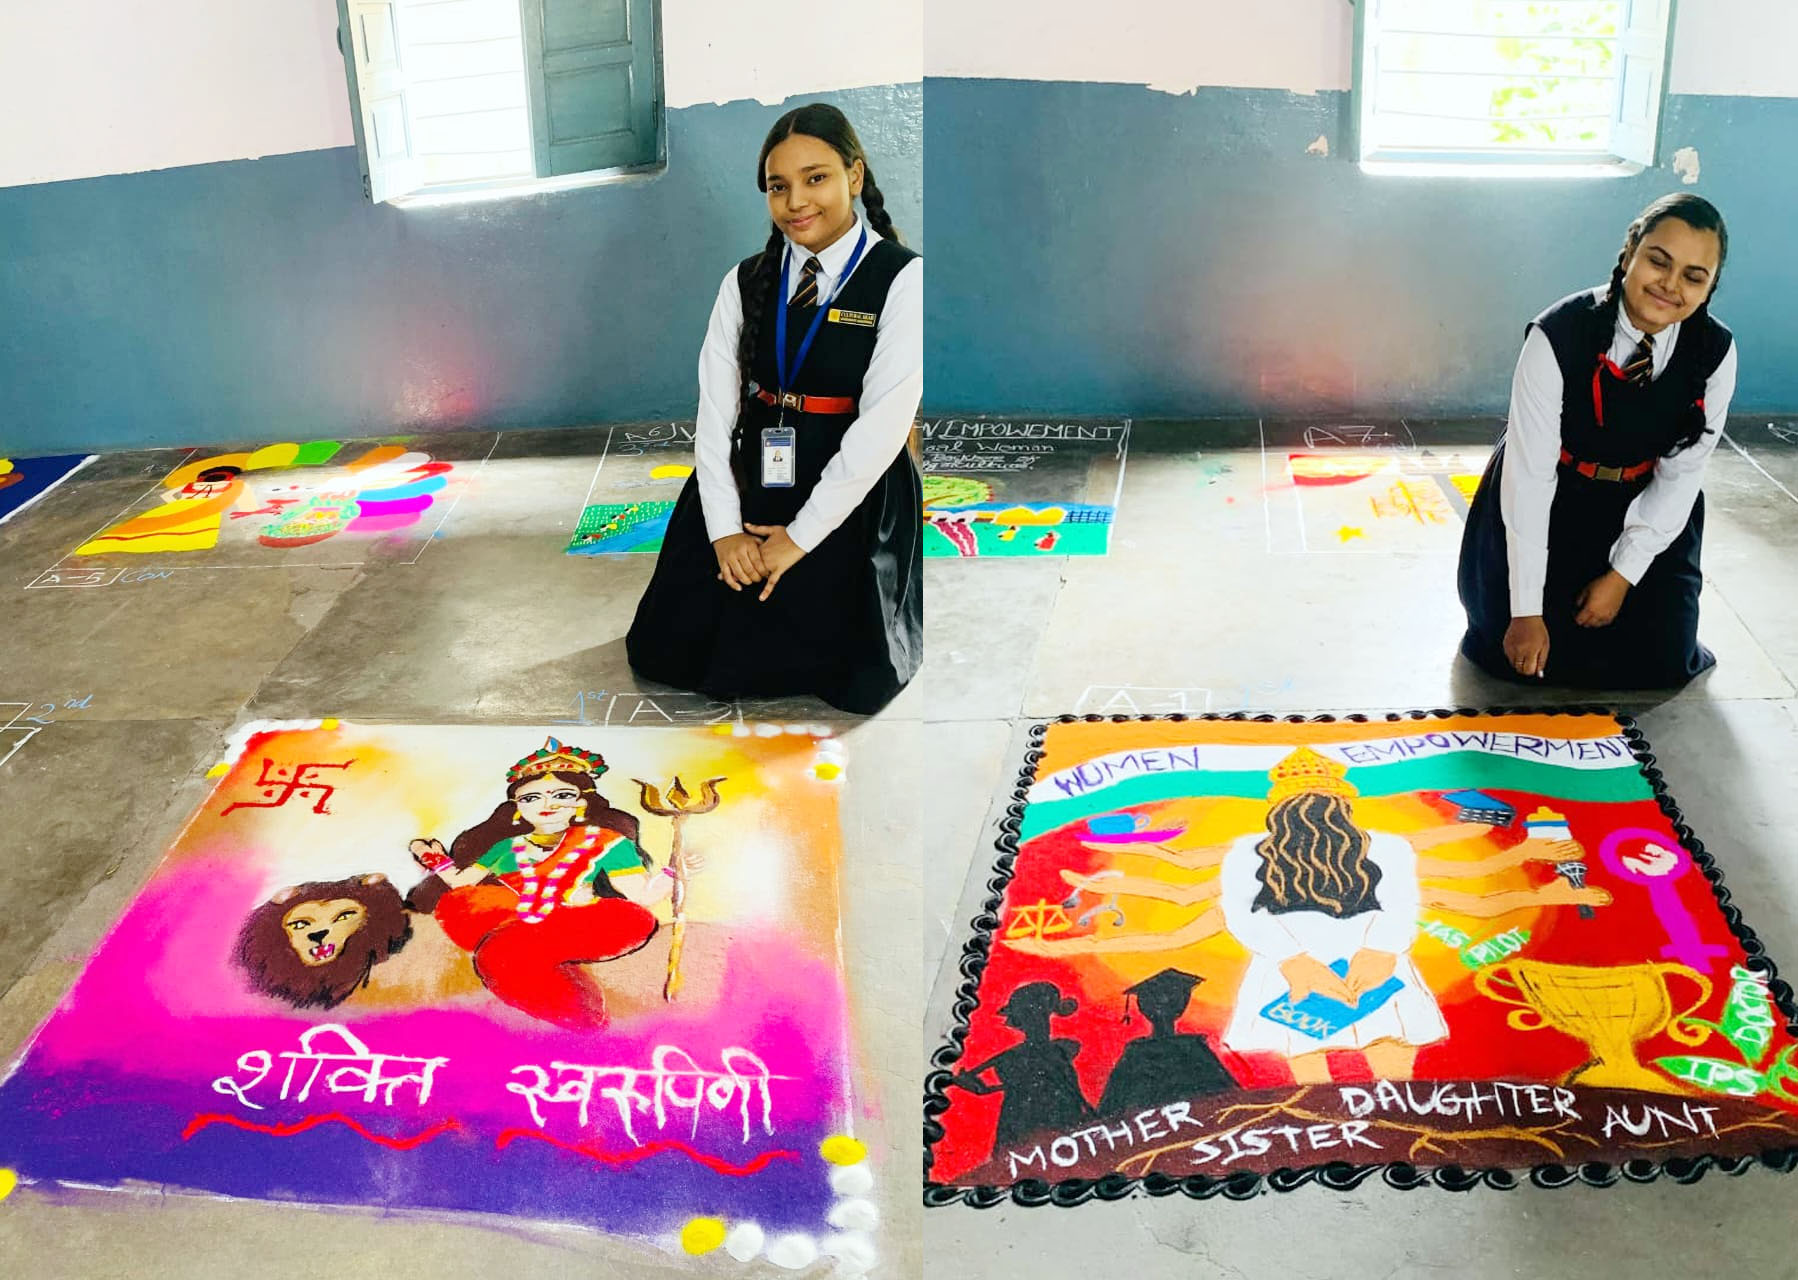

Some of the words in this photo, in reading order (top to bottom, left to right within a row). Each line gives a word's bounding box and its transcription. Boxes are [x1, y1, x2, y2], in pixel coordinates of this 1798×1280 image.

[1468, 926, 1529, 966] PILOT
[1267, 1002, 1337, 1039] BOOK
[1676, 1057, 1763, 1097] IPS
[1009, 1101, 1206, 1179] MOTHER
[1191, 1120, 1384, 1164] SISTER
[1341, 1078, 1581, 1122] DAUGHTER
[1602, 1103, 1720, 1139] AUNT
